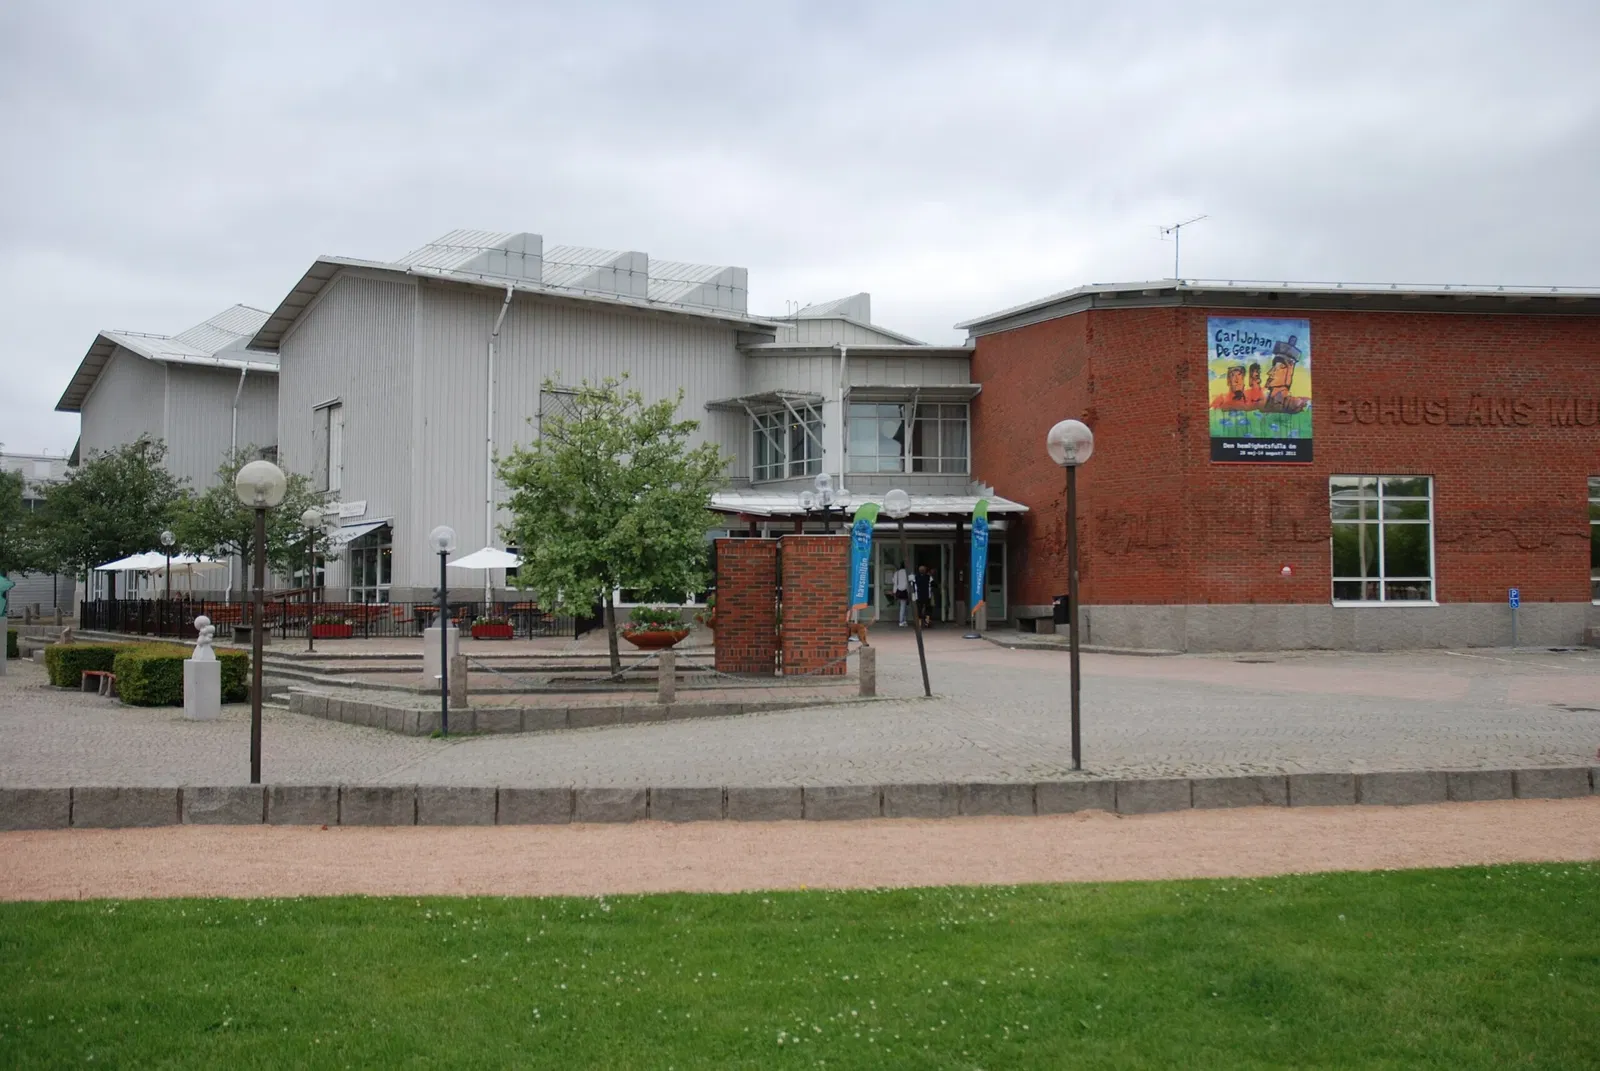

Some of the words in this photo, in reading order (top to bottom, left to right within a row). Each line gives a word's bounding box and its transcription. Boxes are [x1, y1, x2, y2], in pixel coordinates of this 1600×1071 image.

[1215, 329, 1240, 343] Carl
[1241, 331, 1272, 348] Johan
[1216, 344, 1230, 358] De
[1232, 344, 1257, 356] Geer
[1331, 393, 1534, 427] BOHUSLÄNS
[1548, 396, 1600, 426] MU
